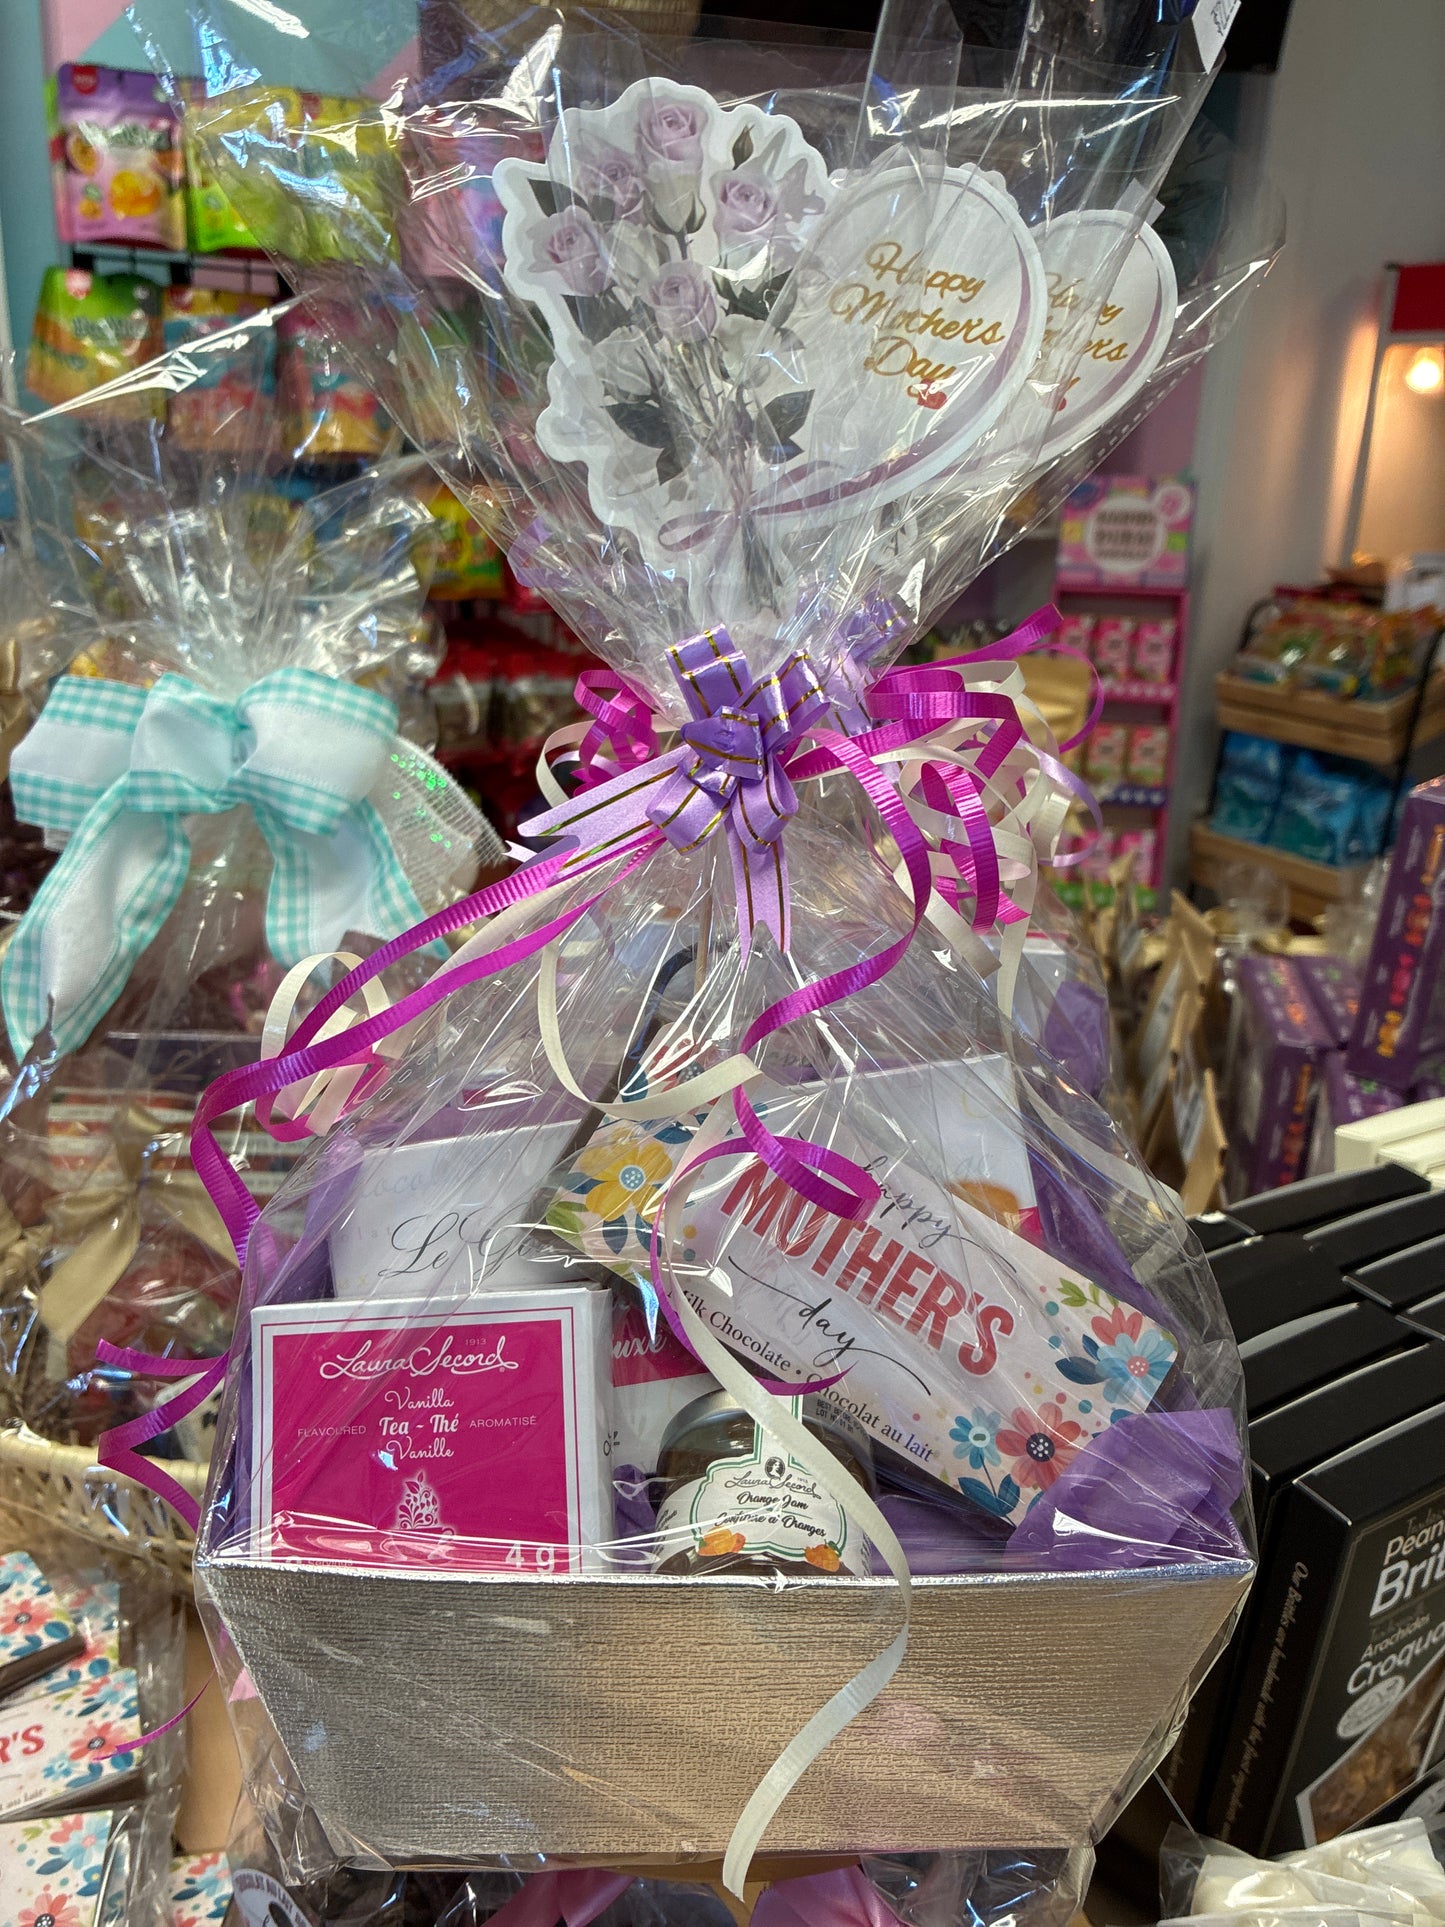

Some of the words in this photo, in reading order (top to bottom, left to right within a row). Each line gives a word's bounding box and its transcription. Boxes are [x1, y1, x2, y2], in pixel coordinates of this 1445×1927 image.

[865, 241, 986, 303] Happy
[828, 283, 1006, 345] Mothers
[319, 1339, 412, 1380] Laura
[409, 1335, 520, 1378] Secord
[384, 1386, 455, 1410] Vanilla
[709, 1310, 792, 1372] Chocolate
[880, 1423, 902, 1444] au
[903, 1434, 935, 1463] lait
[298, 1425, 367, 1438] FLAVOURED
[379, 1416, 409, 1436] Tea
[430, 1413, 460, 1434] Thé
[469, 1415, 537, 1429] AROMATISÉ
[386, 1435, 455, 1460] Vanille
[724, 1471, 771, 1488] Laura
[768, 1473, 822, 1500] Secord
[736, 1490, 780, 1505] Orange
[780, 1494, 809, 1511] Jam
[781, 1514, 828, 1538] Oranges
[505, 1542, 525, 1568] 4
[535, 1546, 556, 1574] g
